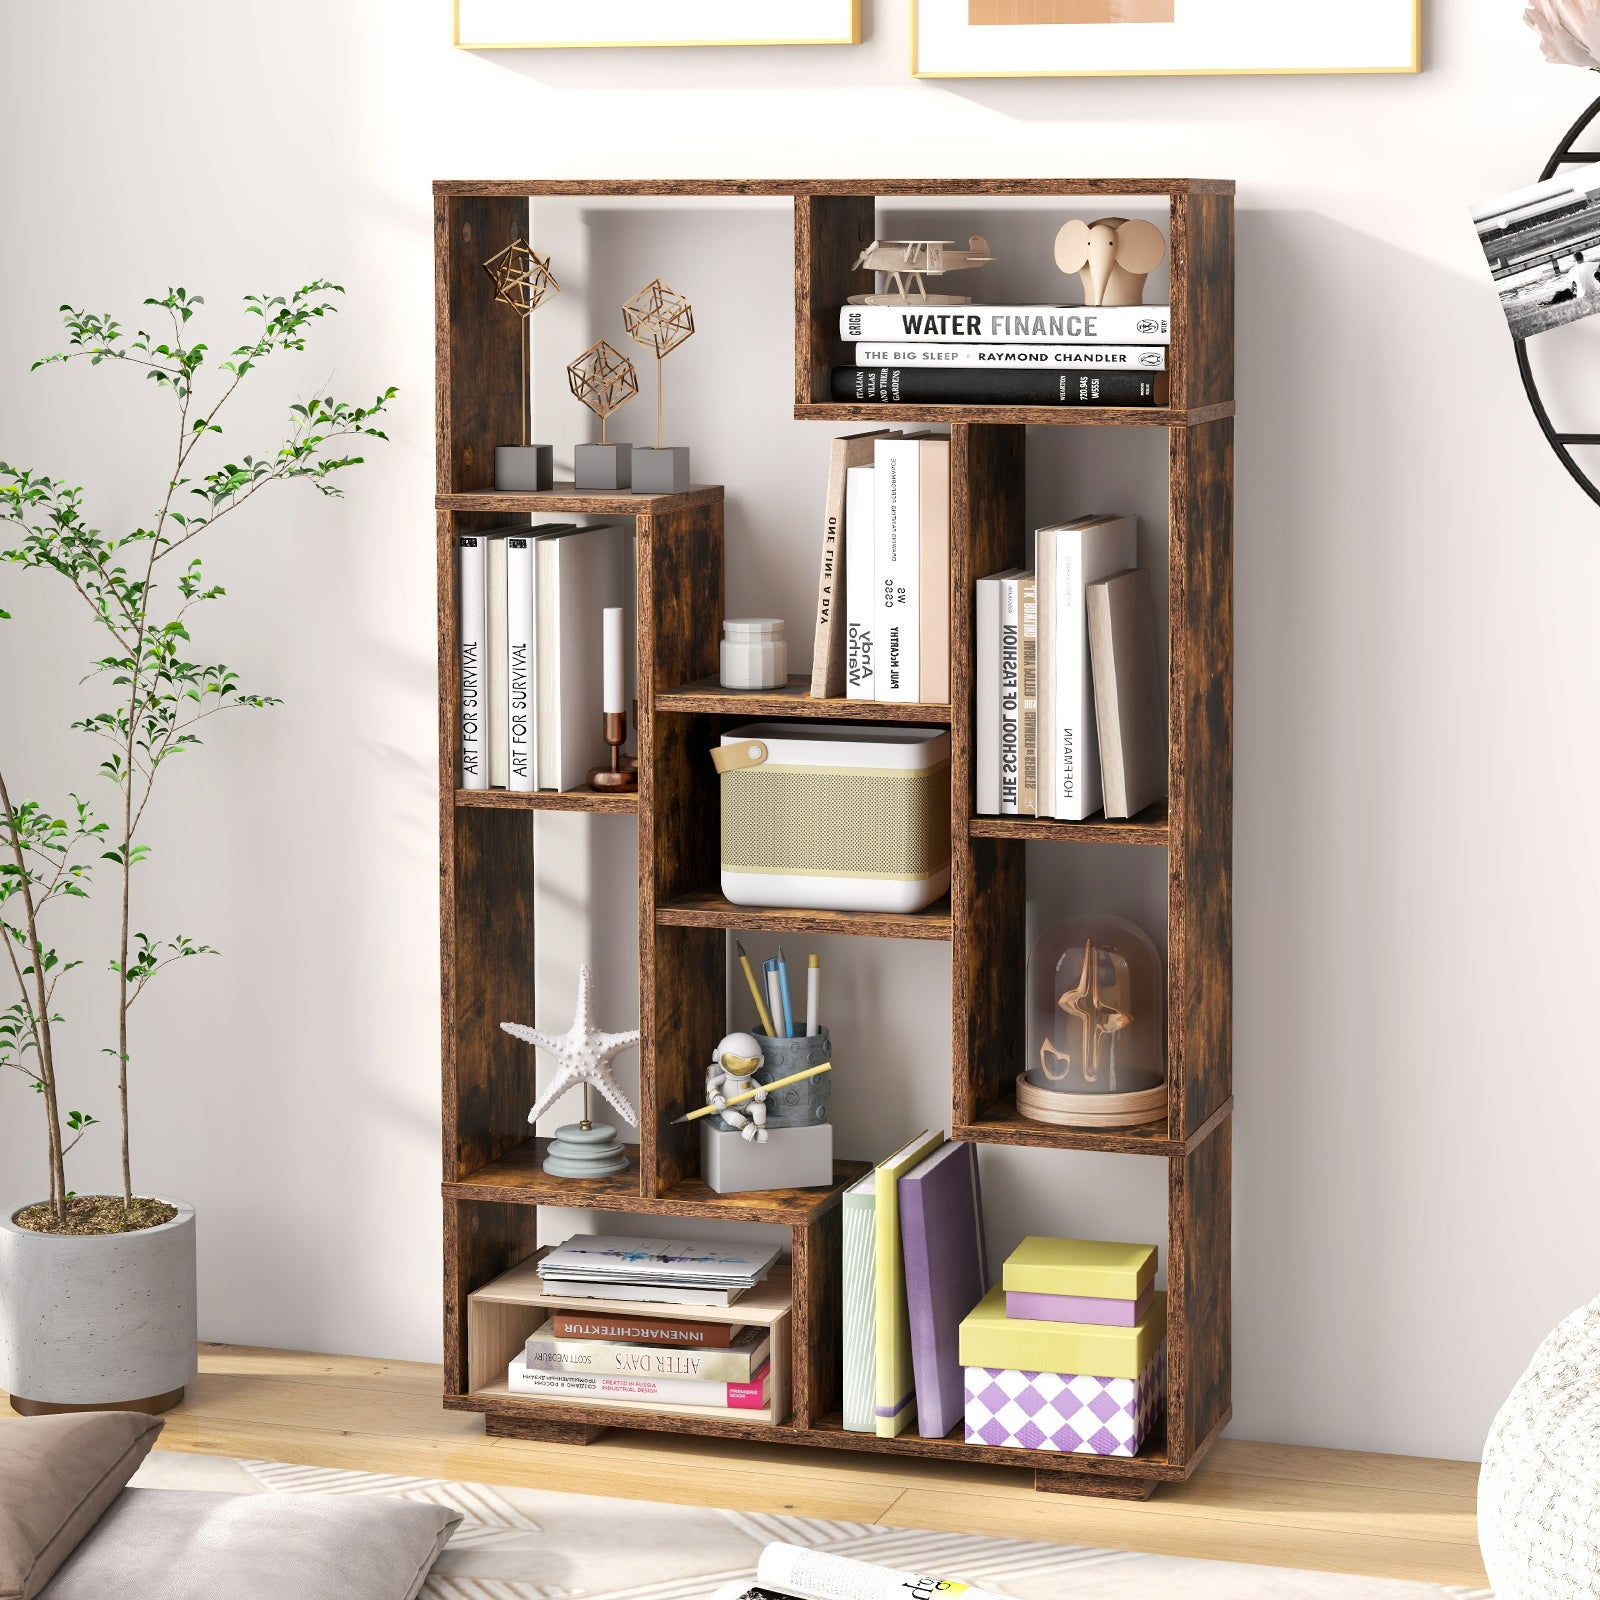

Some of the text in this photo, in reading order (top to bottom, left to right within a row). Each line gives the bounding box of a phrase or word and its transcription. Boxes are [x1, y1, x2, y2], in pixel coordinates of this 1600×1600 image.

[849, 313, 861, 336] GRIGG
[902, 314, 1097, 336] WATER FINANCE
[864, 350, 1128, 364] THE BIG SLEEP RAYMOND CHANDLER
[856, 371, 864, 399] ITALIAN
[868, 373, 876, 397] VILLAS
[880, 368, 889, 402] AND THEIR
[892, 370, 900, 401] GARDENS
[1080, 376, 1088, 400] 720.945
[463, 641, 478, 775] ART FOR SURVIVAL
[512, 643, 527, 777] ART FOR SURVIVAL
[564, 1323, 704, 1340] INNENARCHITEKTUR
[534, 1352, 592, 1365] SCOTT MEDBURY
[615, 1353, 700, 1375] AFTER DAYS
[601, 1379, 627, 1387] CREATED
[601, 1385, 636, 1393] INDUSTRIAL
